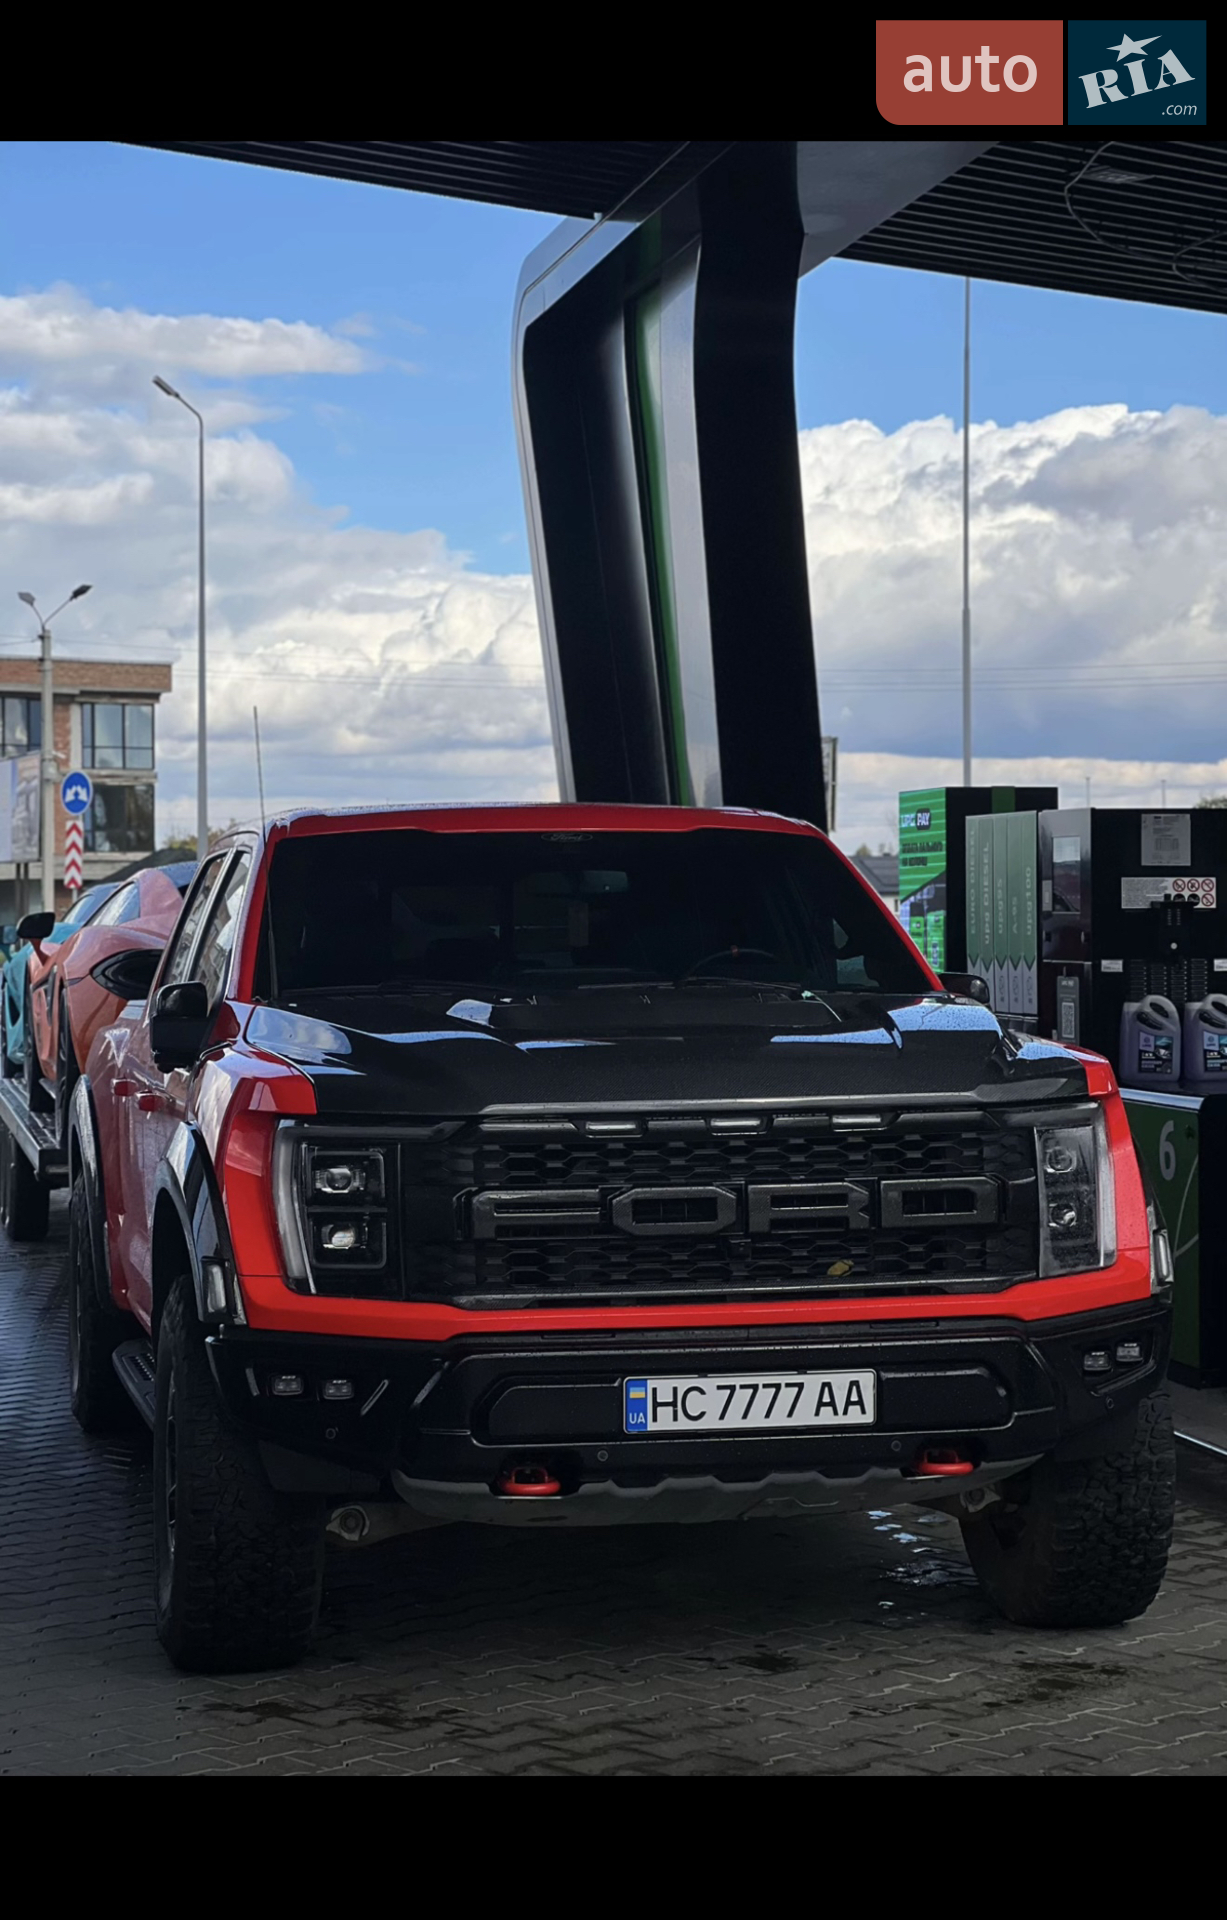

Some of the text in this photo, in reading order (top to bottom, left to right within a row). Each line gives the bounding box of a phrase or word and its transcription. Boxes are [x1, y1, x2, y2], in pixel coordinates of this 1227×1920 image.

[916, 812, 931, 826] PAY
[1025, 866, 1033, 936] upg100
[1159, 1119, 1176, 1181] 6
[471, 1176, 1000, 1239] FORD
[629, 1412, 646, 1425] UA
[651, 1380, 867, 1423] HC 7777 AA
